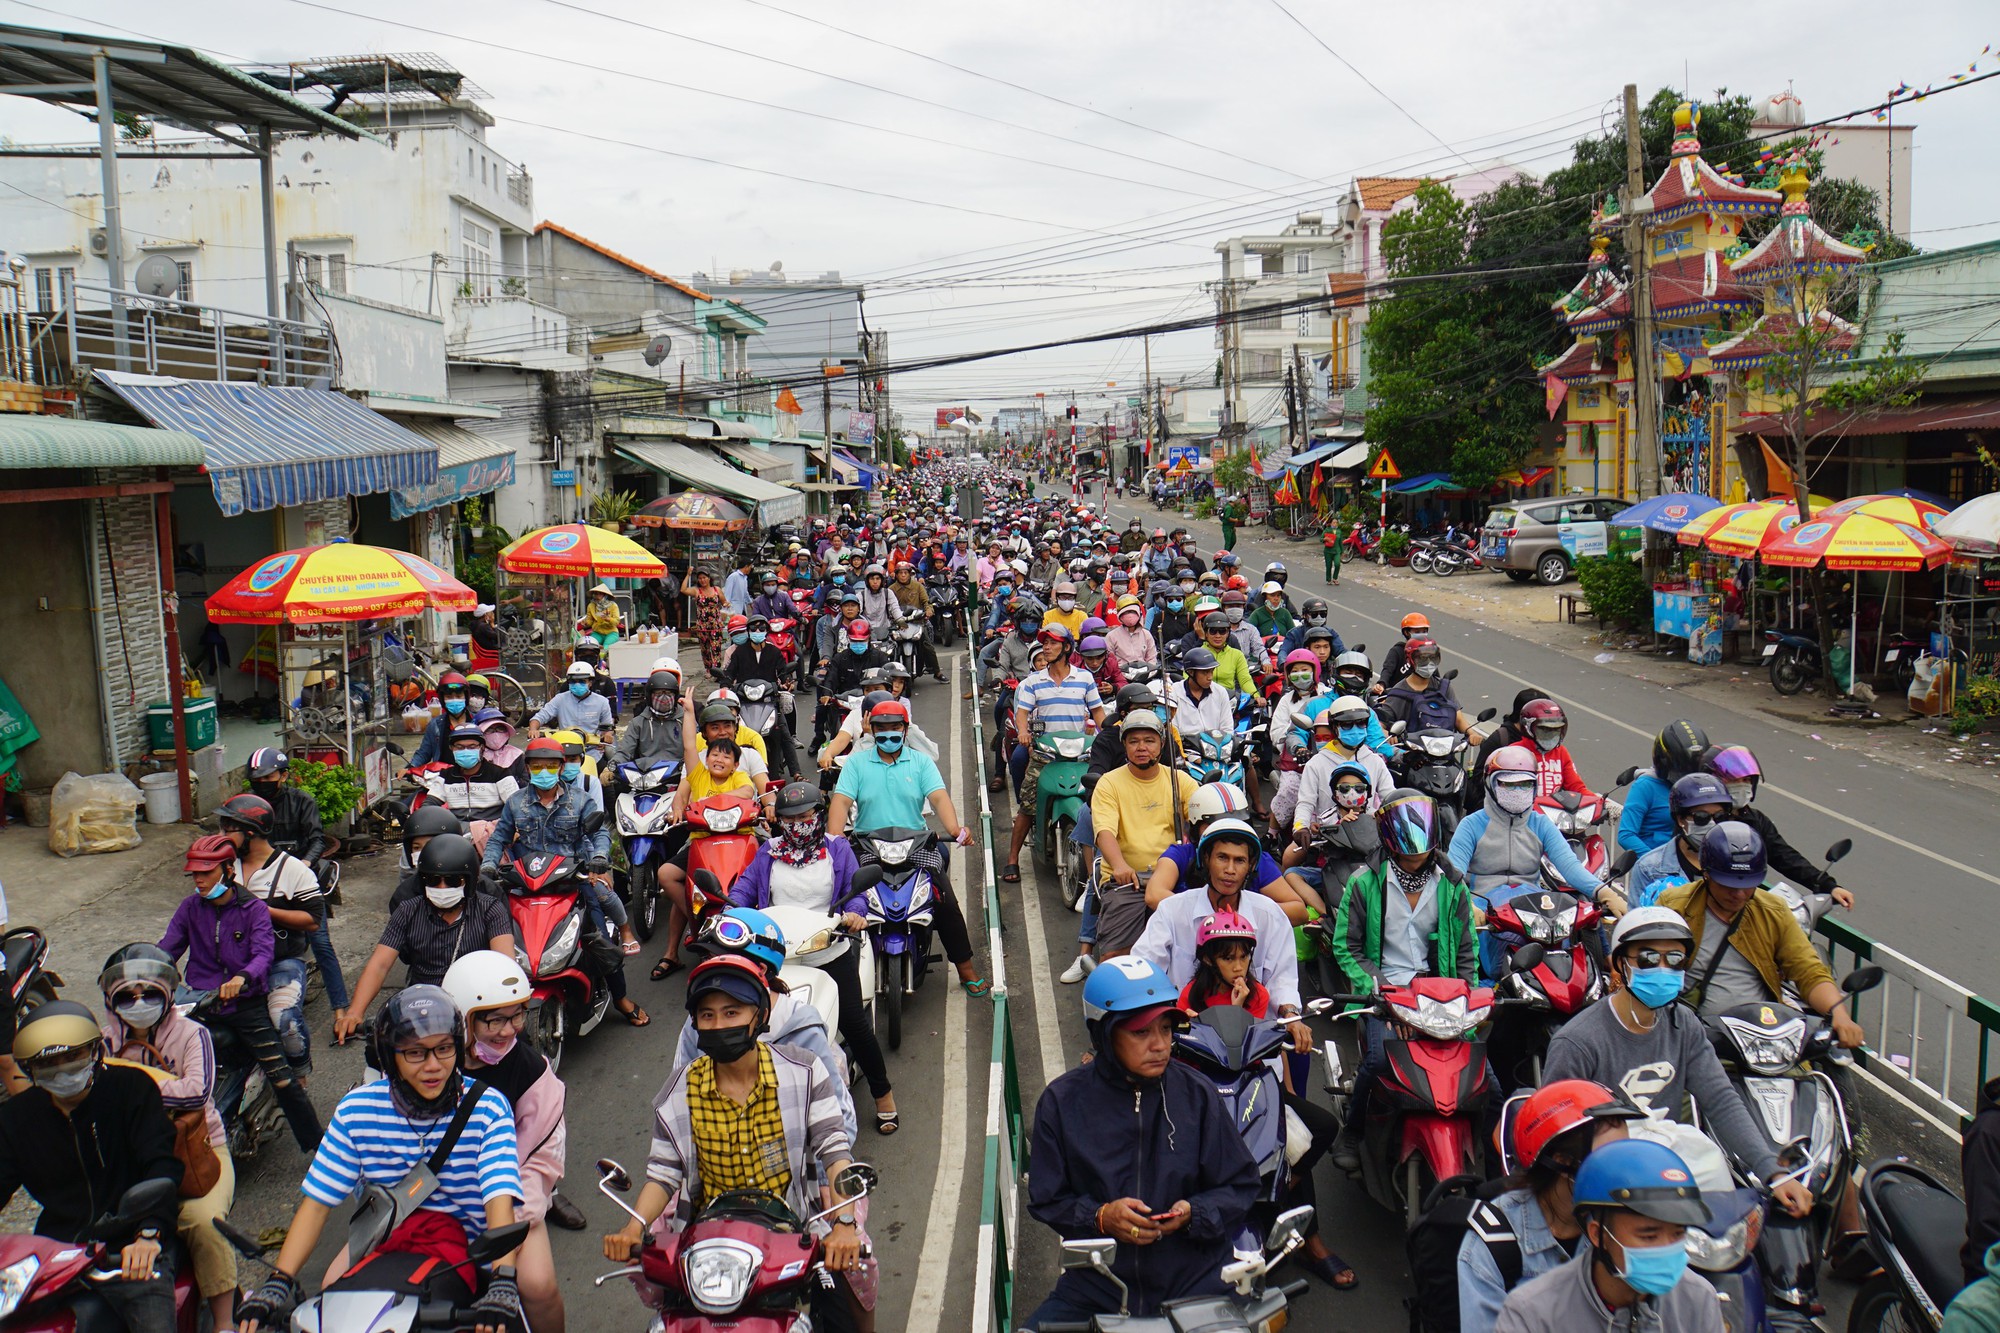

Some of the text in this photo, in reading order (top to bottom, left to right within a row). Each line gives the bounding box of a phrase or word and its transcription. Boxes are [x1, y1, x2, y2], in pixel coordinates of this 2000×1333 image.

[299, 570, 408, 585] CHUYÊN KINH DOANH ĐẤT
[291, 609, 306, 618] ĐT:
[307, 608, 323, 616] 038
[325, 606, 341, 615] 596
[342, 605, 364, 614] 9999
[370, 603, 386, 611] 037
[387, 601, 402, 609] 556
[404, 599, 424, 608] 9999
